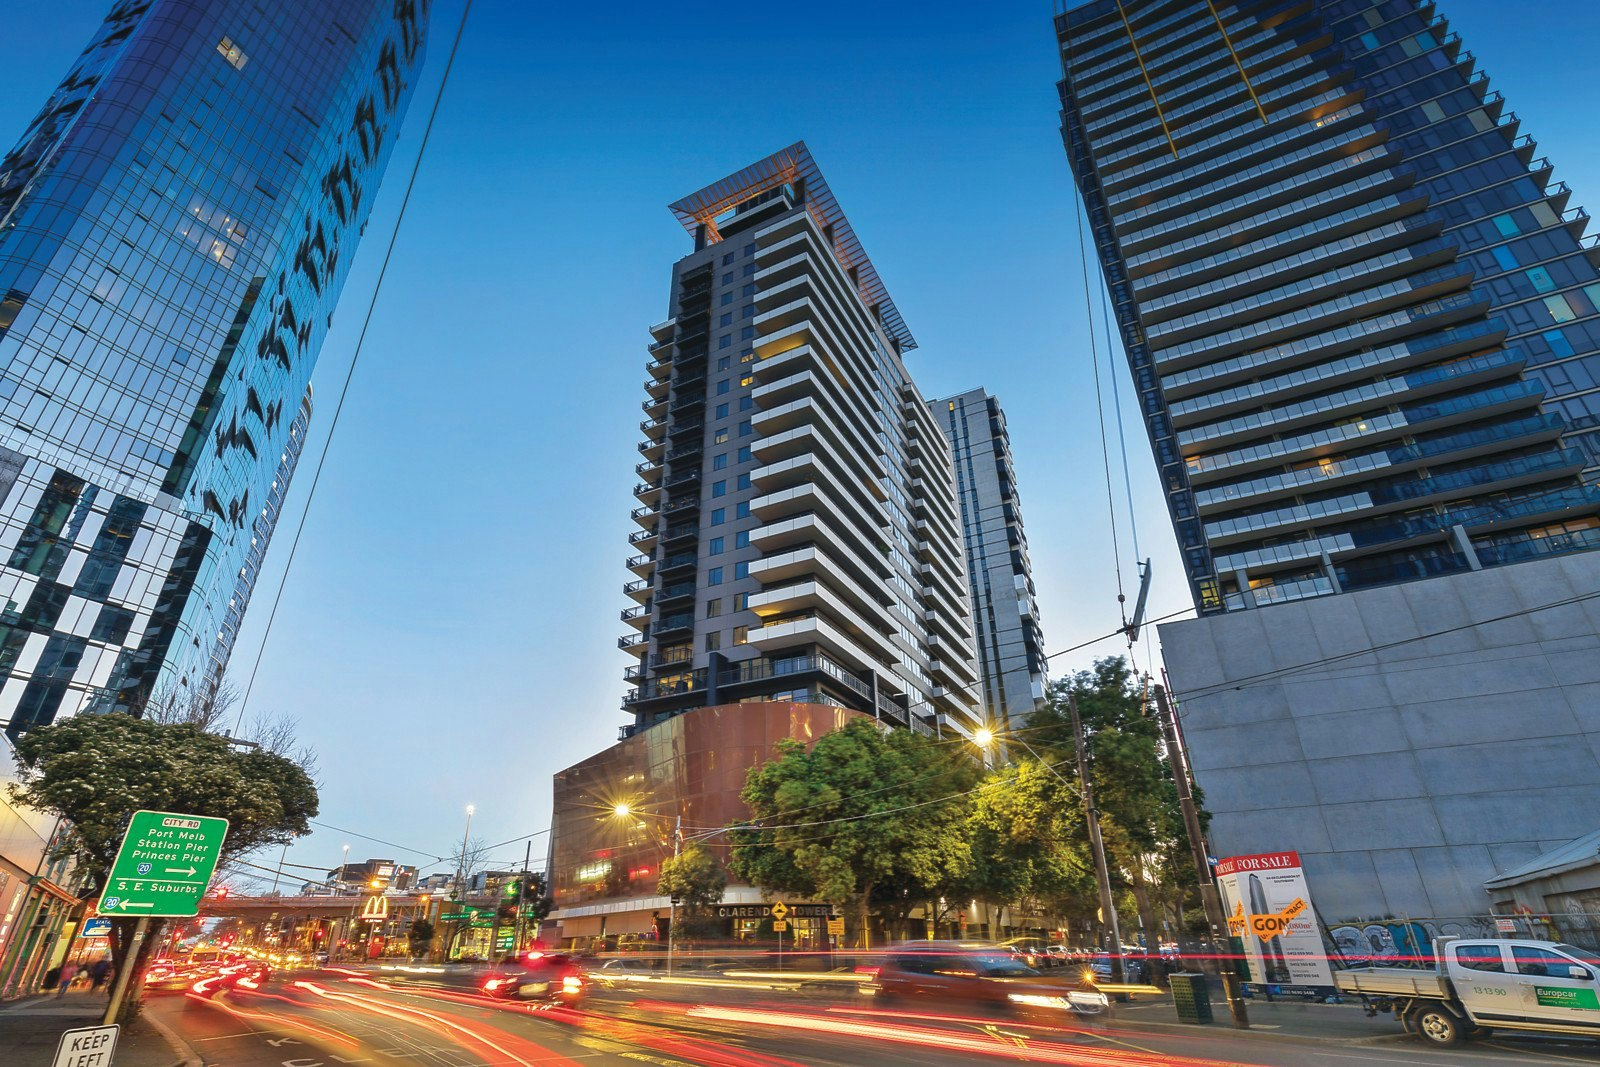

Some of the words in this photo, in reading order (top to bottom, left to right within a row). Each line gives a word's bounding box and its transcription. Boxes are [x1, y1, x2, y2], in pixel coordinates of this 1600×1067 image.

[164, 818, 183, 827] CITY
[187, 820, 199, 828] RD
[148, 828, 174, 838] Port
[178, 831, 205, 841] Melb
[137, 839, 180, 850] Station
[185, 843, 209, 852] Pier
[132, 850, 177, 861] Princes
[182, 853, 206, 863] Pier
[1237, 858, 1261, 870] FOR
[1259, 855, 1292, 868] SALE
[139, 864, 150, 873] 20
[117, 881, 128, 891] S.
[133, 882, 144, 891] E.
[150, 883, 197, 894] Suburbs
[106, 898, 117, 907] 20
[719, 906, 771, 918] CLAREND
[1253, 917, 1291, 931] GON
[1473, 986, 1483, 995] 13
[1483, 987, 1493, 996] 13
[1494, 988, 1507, 997] 90
[1537, 988, 1577, 998] Europcar
[71, 1034, 110, 1052] KEEP
[67, 1052, 104, 1067] LEFT
